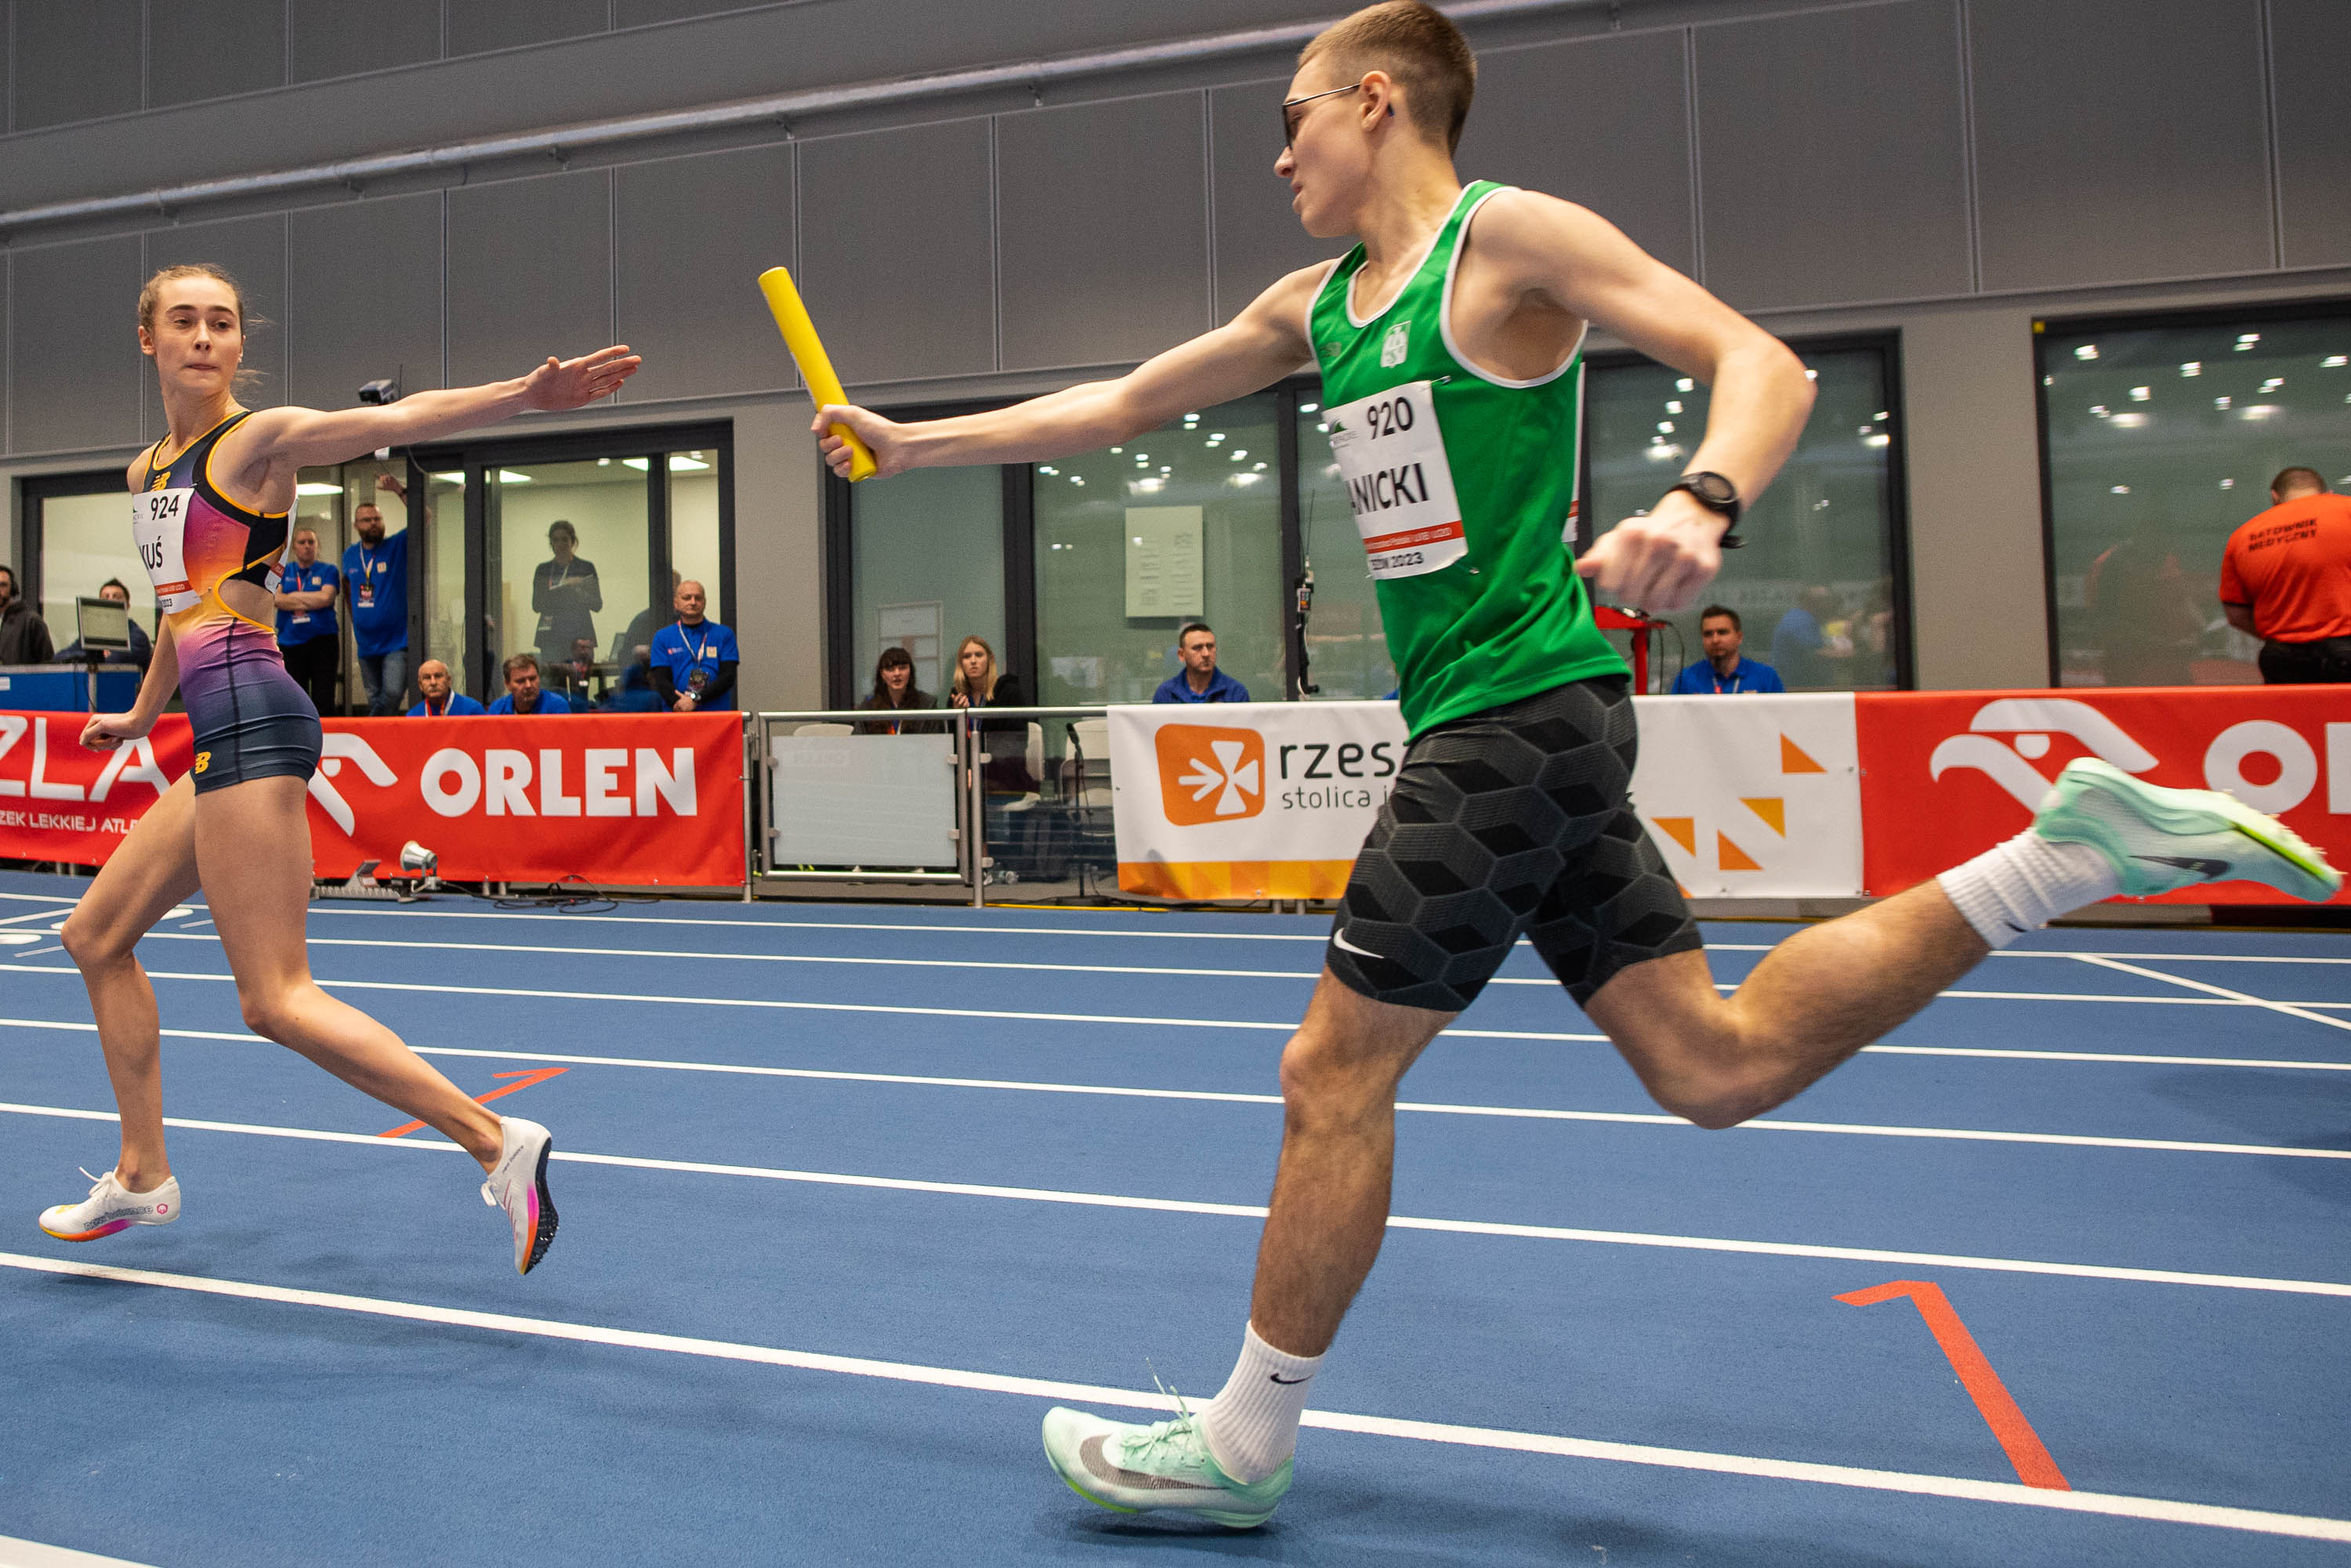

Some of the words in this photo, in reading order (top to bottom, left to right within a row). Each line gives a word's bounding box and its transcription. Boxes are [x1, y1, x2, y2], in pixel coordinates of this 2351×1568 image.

[1367, 397, 1414, 440] 920
[150, 494, 180, 520] 924
[1391, 551, 1424, 568] 2023
[1280, 741, 1410, 779] rzes
[420, 747, 697, 817] ORLEN
[1282, 786, 1371, 809] stolica
[29, 813, 96, 831] LEKKIEJ
